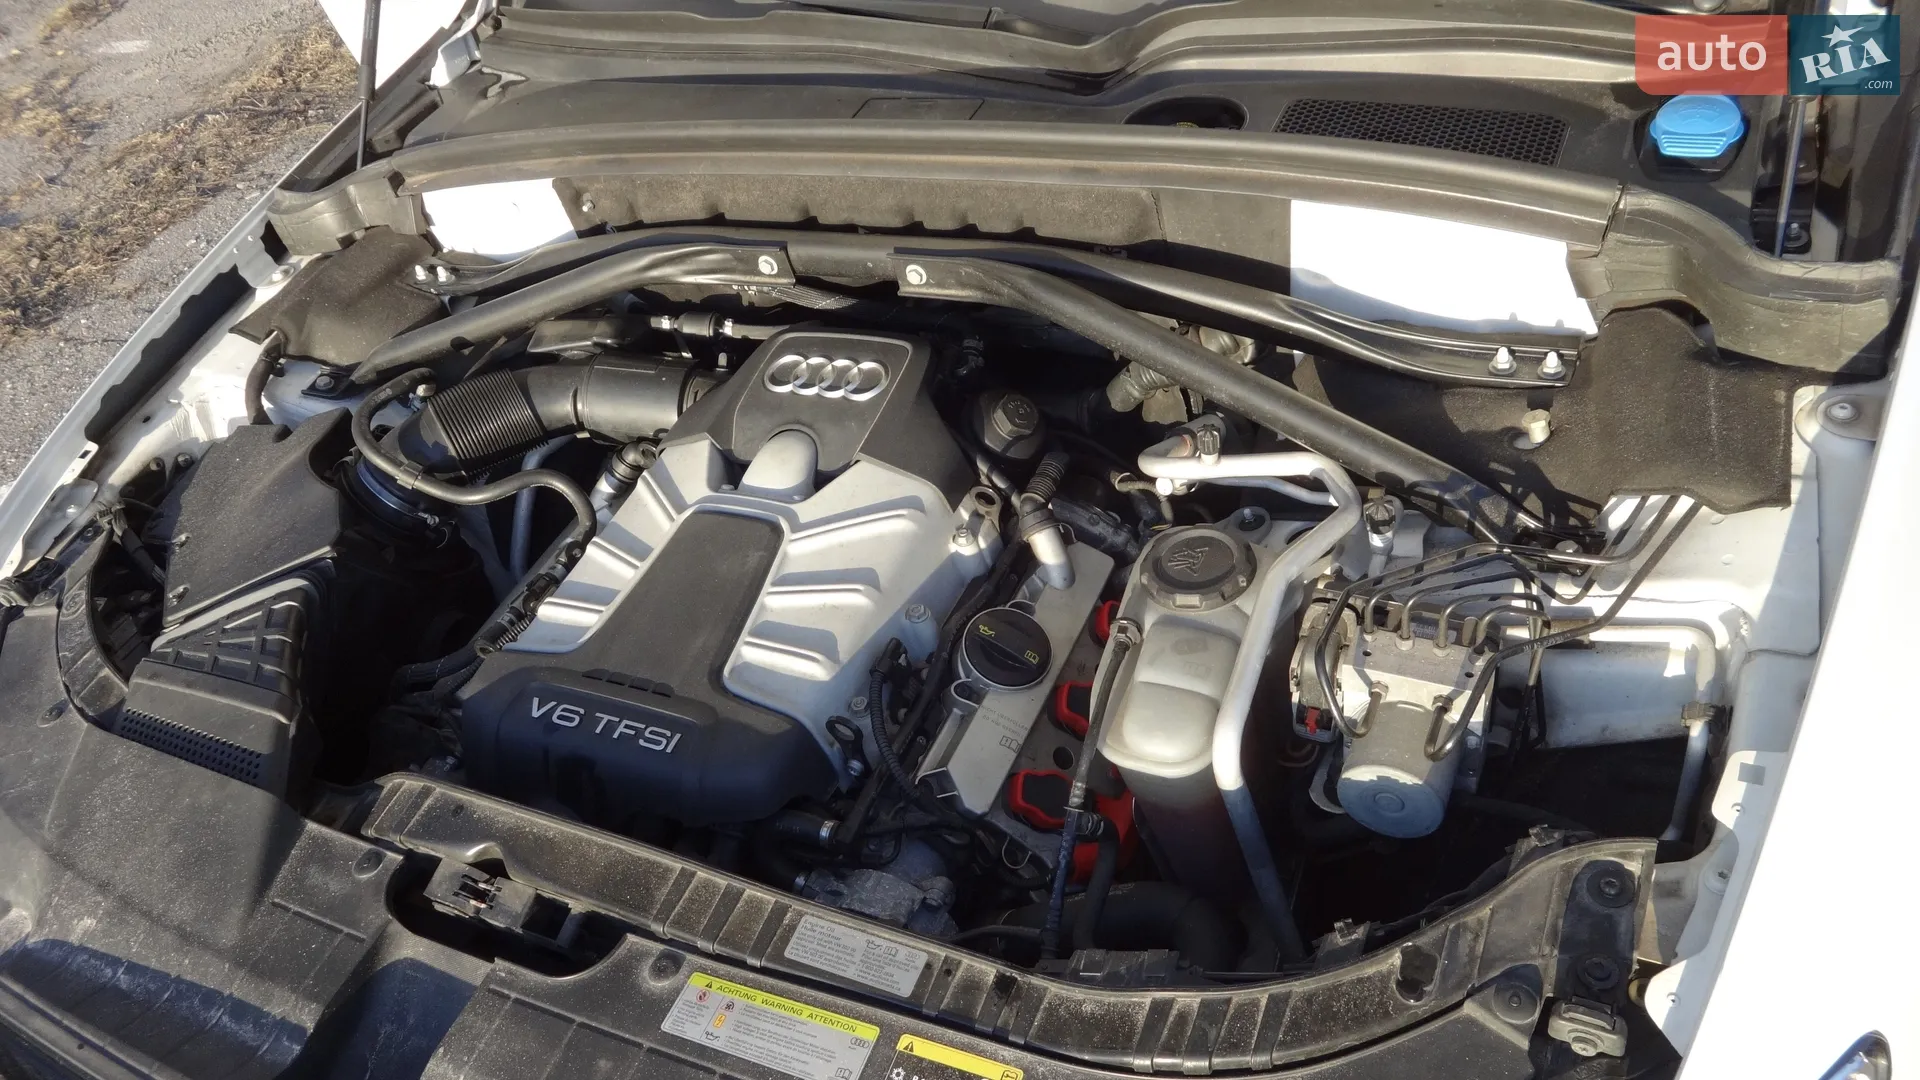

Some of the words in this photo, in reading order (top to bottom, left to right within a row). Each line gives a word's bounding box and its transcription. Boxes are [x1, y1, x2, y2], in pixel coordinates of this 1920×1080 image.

[531, 697, 585, 728] V6
[594, 712, 682, 753] TFSI
[817, 930, 842, 941] moteur
[716, 985, 757, 1002] ACHTUNG
[760, 998, 804, 1016] WARNING
[806, 1012, 857, 1033] ATTENTION
